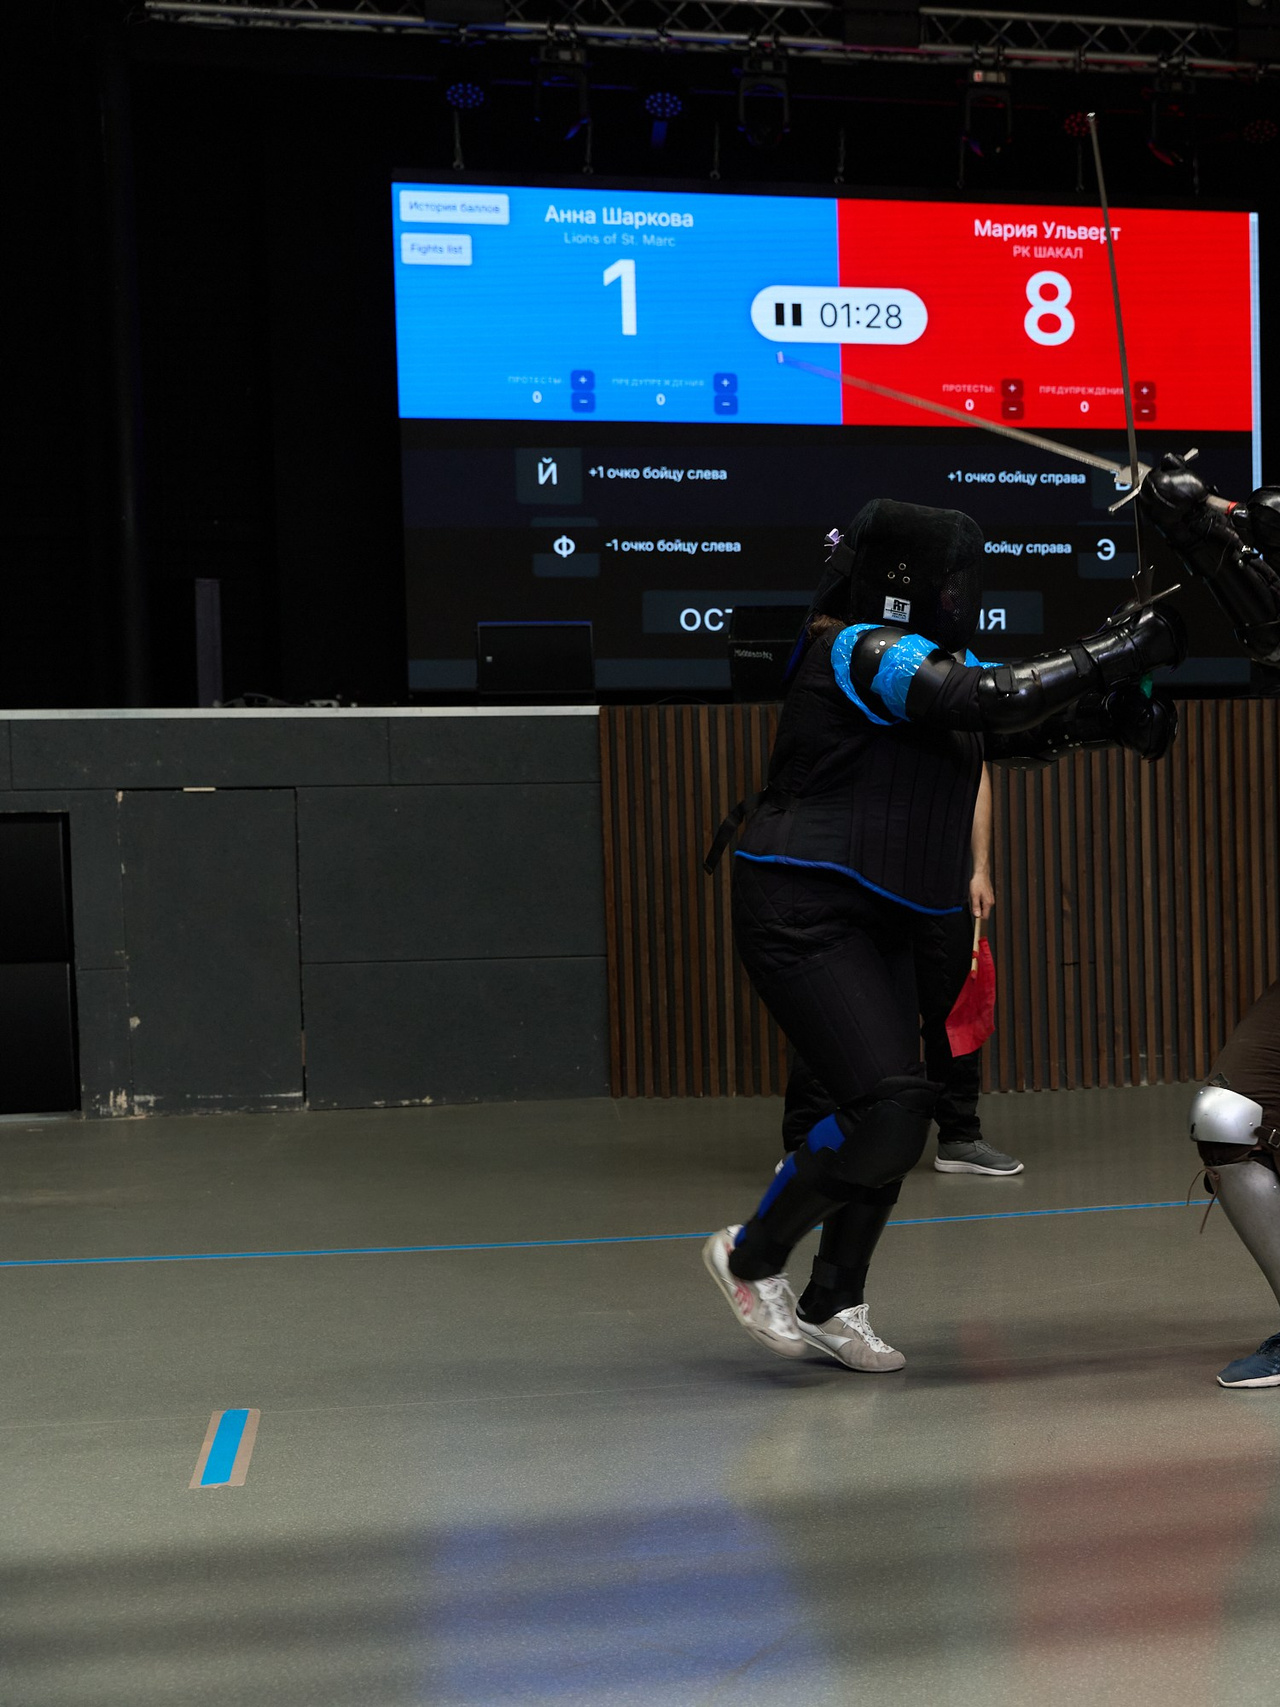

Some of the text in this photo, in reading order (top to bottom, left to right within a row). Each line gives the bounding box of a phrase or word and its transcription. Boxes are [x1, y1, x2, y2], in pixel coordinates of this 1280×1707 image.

[408, 202, 500, 214] История баллов
[544, 204, 694, 230] Анна Шаркова
[563, 231, 676, 247] Lions of St. Marc
[974, 218, 1121, 244] Мария Ульверт
[410, 244, 463, 256] Fights list
[1012, 245, 1084, 259] РК ШАКАЛ
[603, 258, 637, 336] 1
[819, 302, 902, 330] 01:28
[1024, 270, 1075, 346] 8
[532, 390, 542, 403] 0
[656, 393, 666, 406] 0
[965, 398, 975, 411] 0
[1080, 400, 1090, 413] 0
[537, 457, 558, 485] Й
[588, 466, 728, 482] +1 очко бойцу слева
[947, 470, 1086, 486] +1 очко бойцу справа
[553, 535, 576, 558] Ф
[605, 539, 741, 554] -1 очко бойцу слева
[984, 540, 1072, 556] бойцу справа
[1096, 538, 1116, 561] Э
